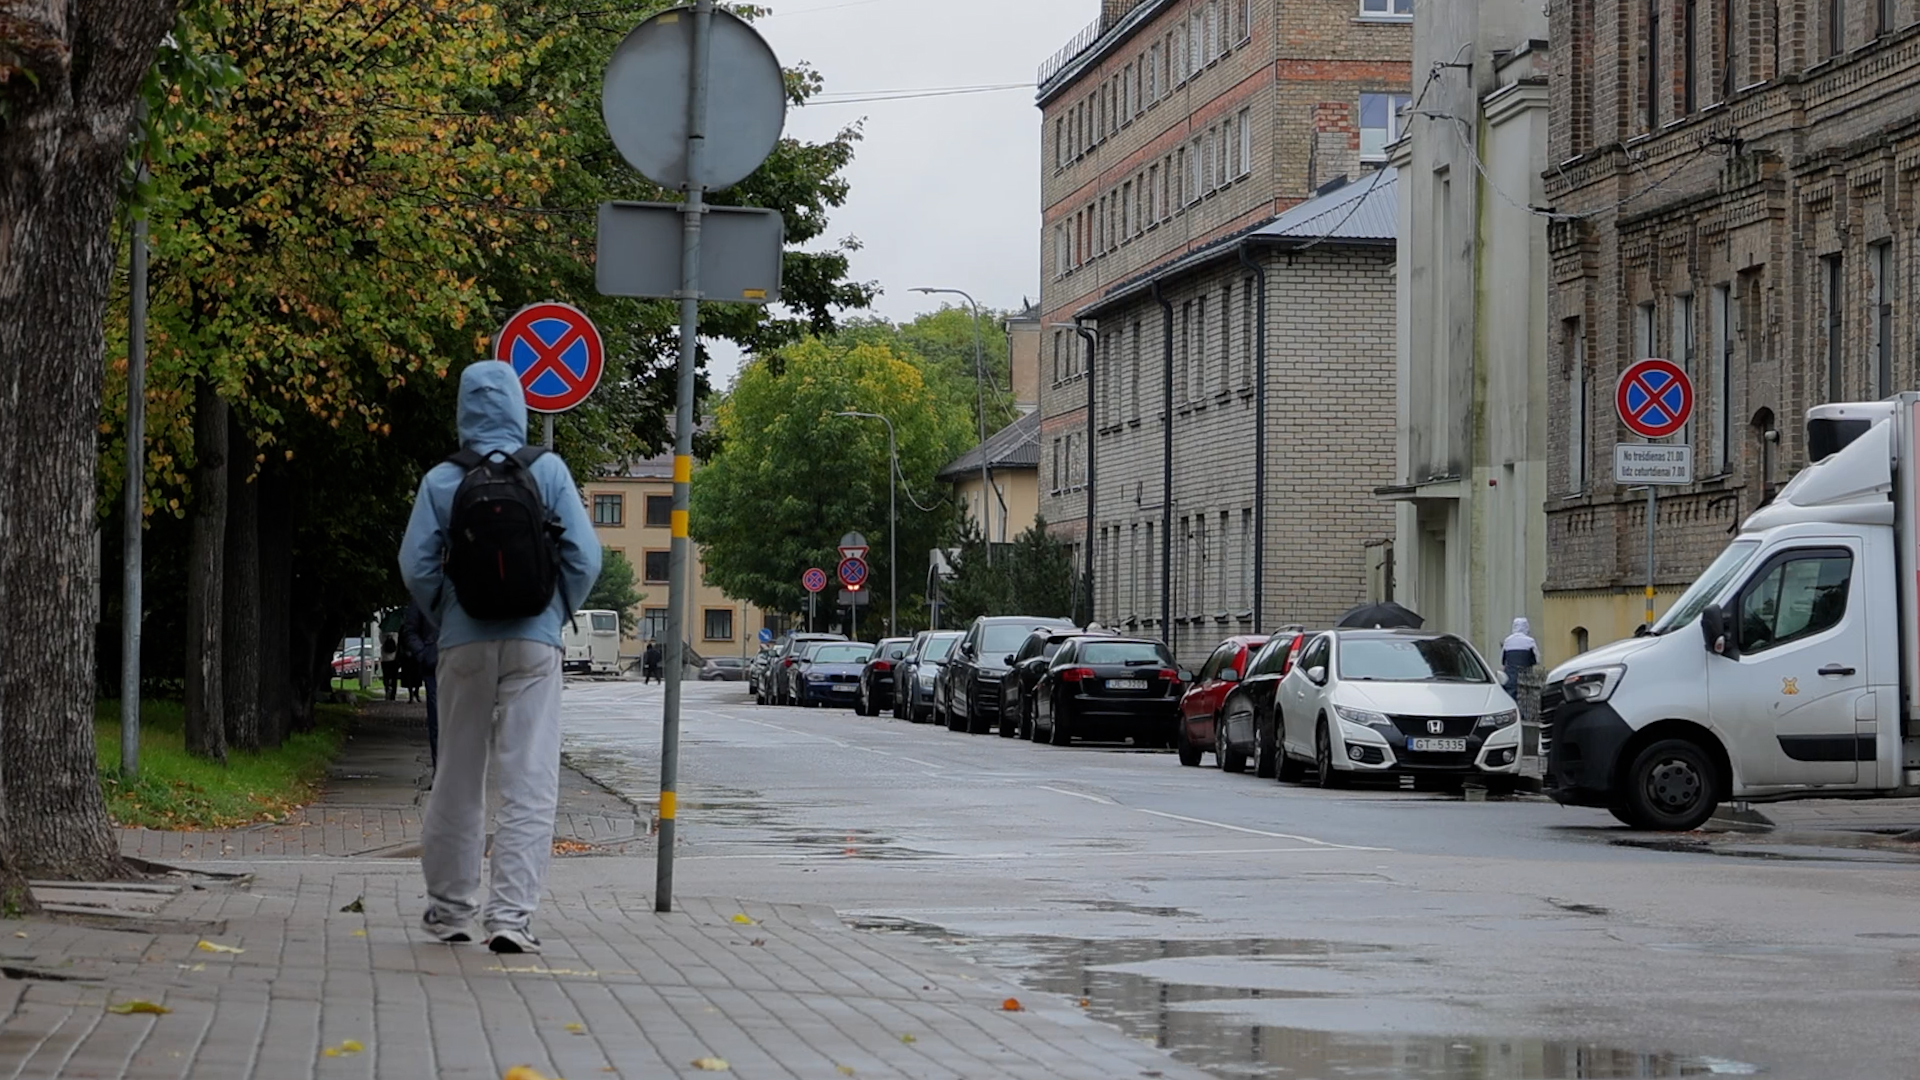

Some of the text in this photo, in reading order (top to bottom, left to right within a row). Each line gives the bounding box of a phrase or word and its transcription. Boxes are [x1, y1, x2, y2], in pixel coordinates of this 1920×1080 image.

[1623, 450, 1632, 461] No
[1667, 450, 1684, 461] 21.00
[1672, 466, 1685, 477] 7.00
[1415, 740, 1465, 750] GT-5335
